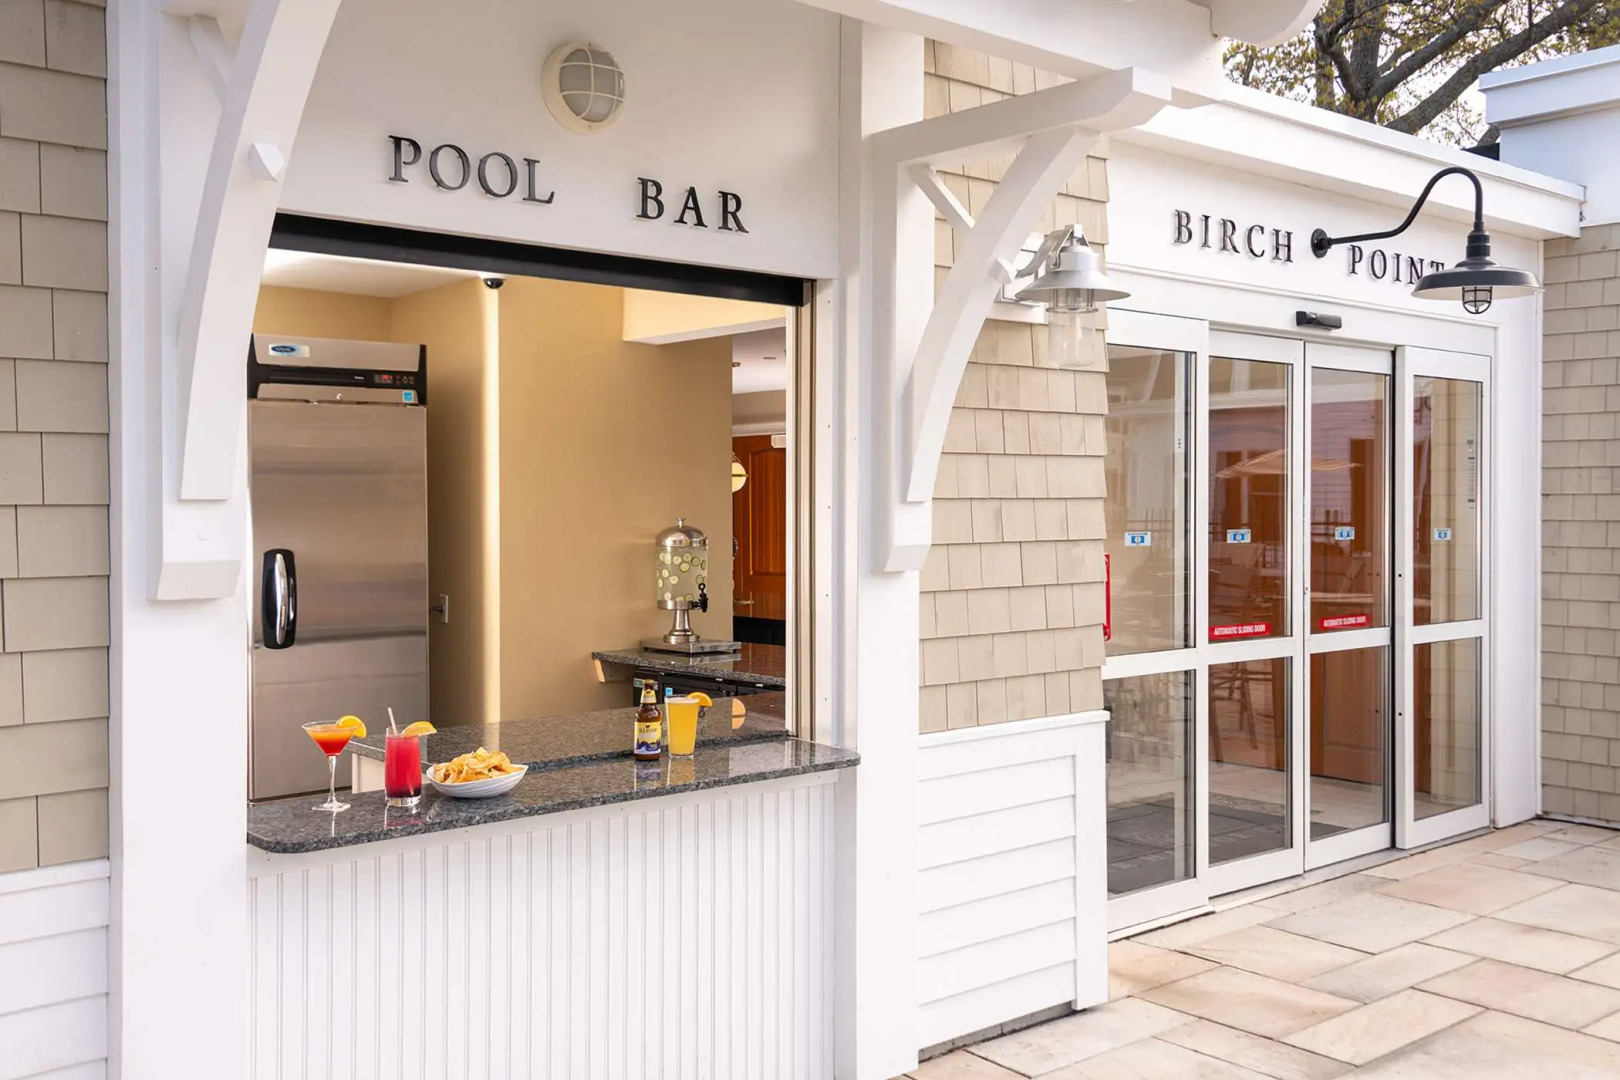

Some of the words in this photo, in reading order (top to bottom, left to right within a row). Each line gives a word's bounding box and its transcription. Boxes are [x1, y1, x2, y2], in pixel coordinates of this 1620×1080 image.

[388, 135, 555, 205] POOL
[636, 177, 750, 234] BAR
[1174, 209, 1294, 263] BIRCH
